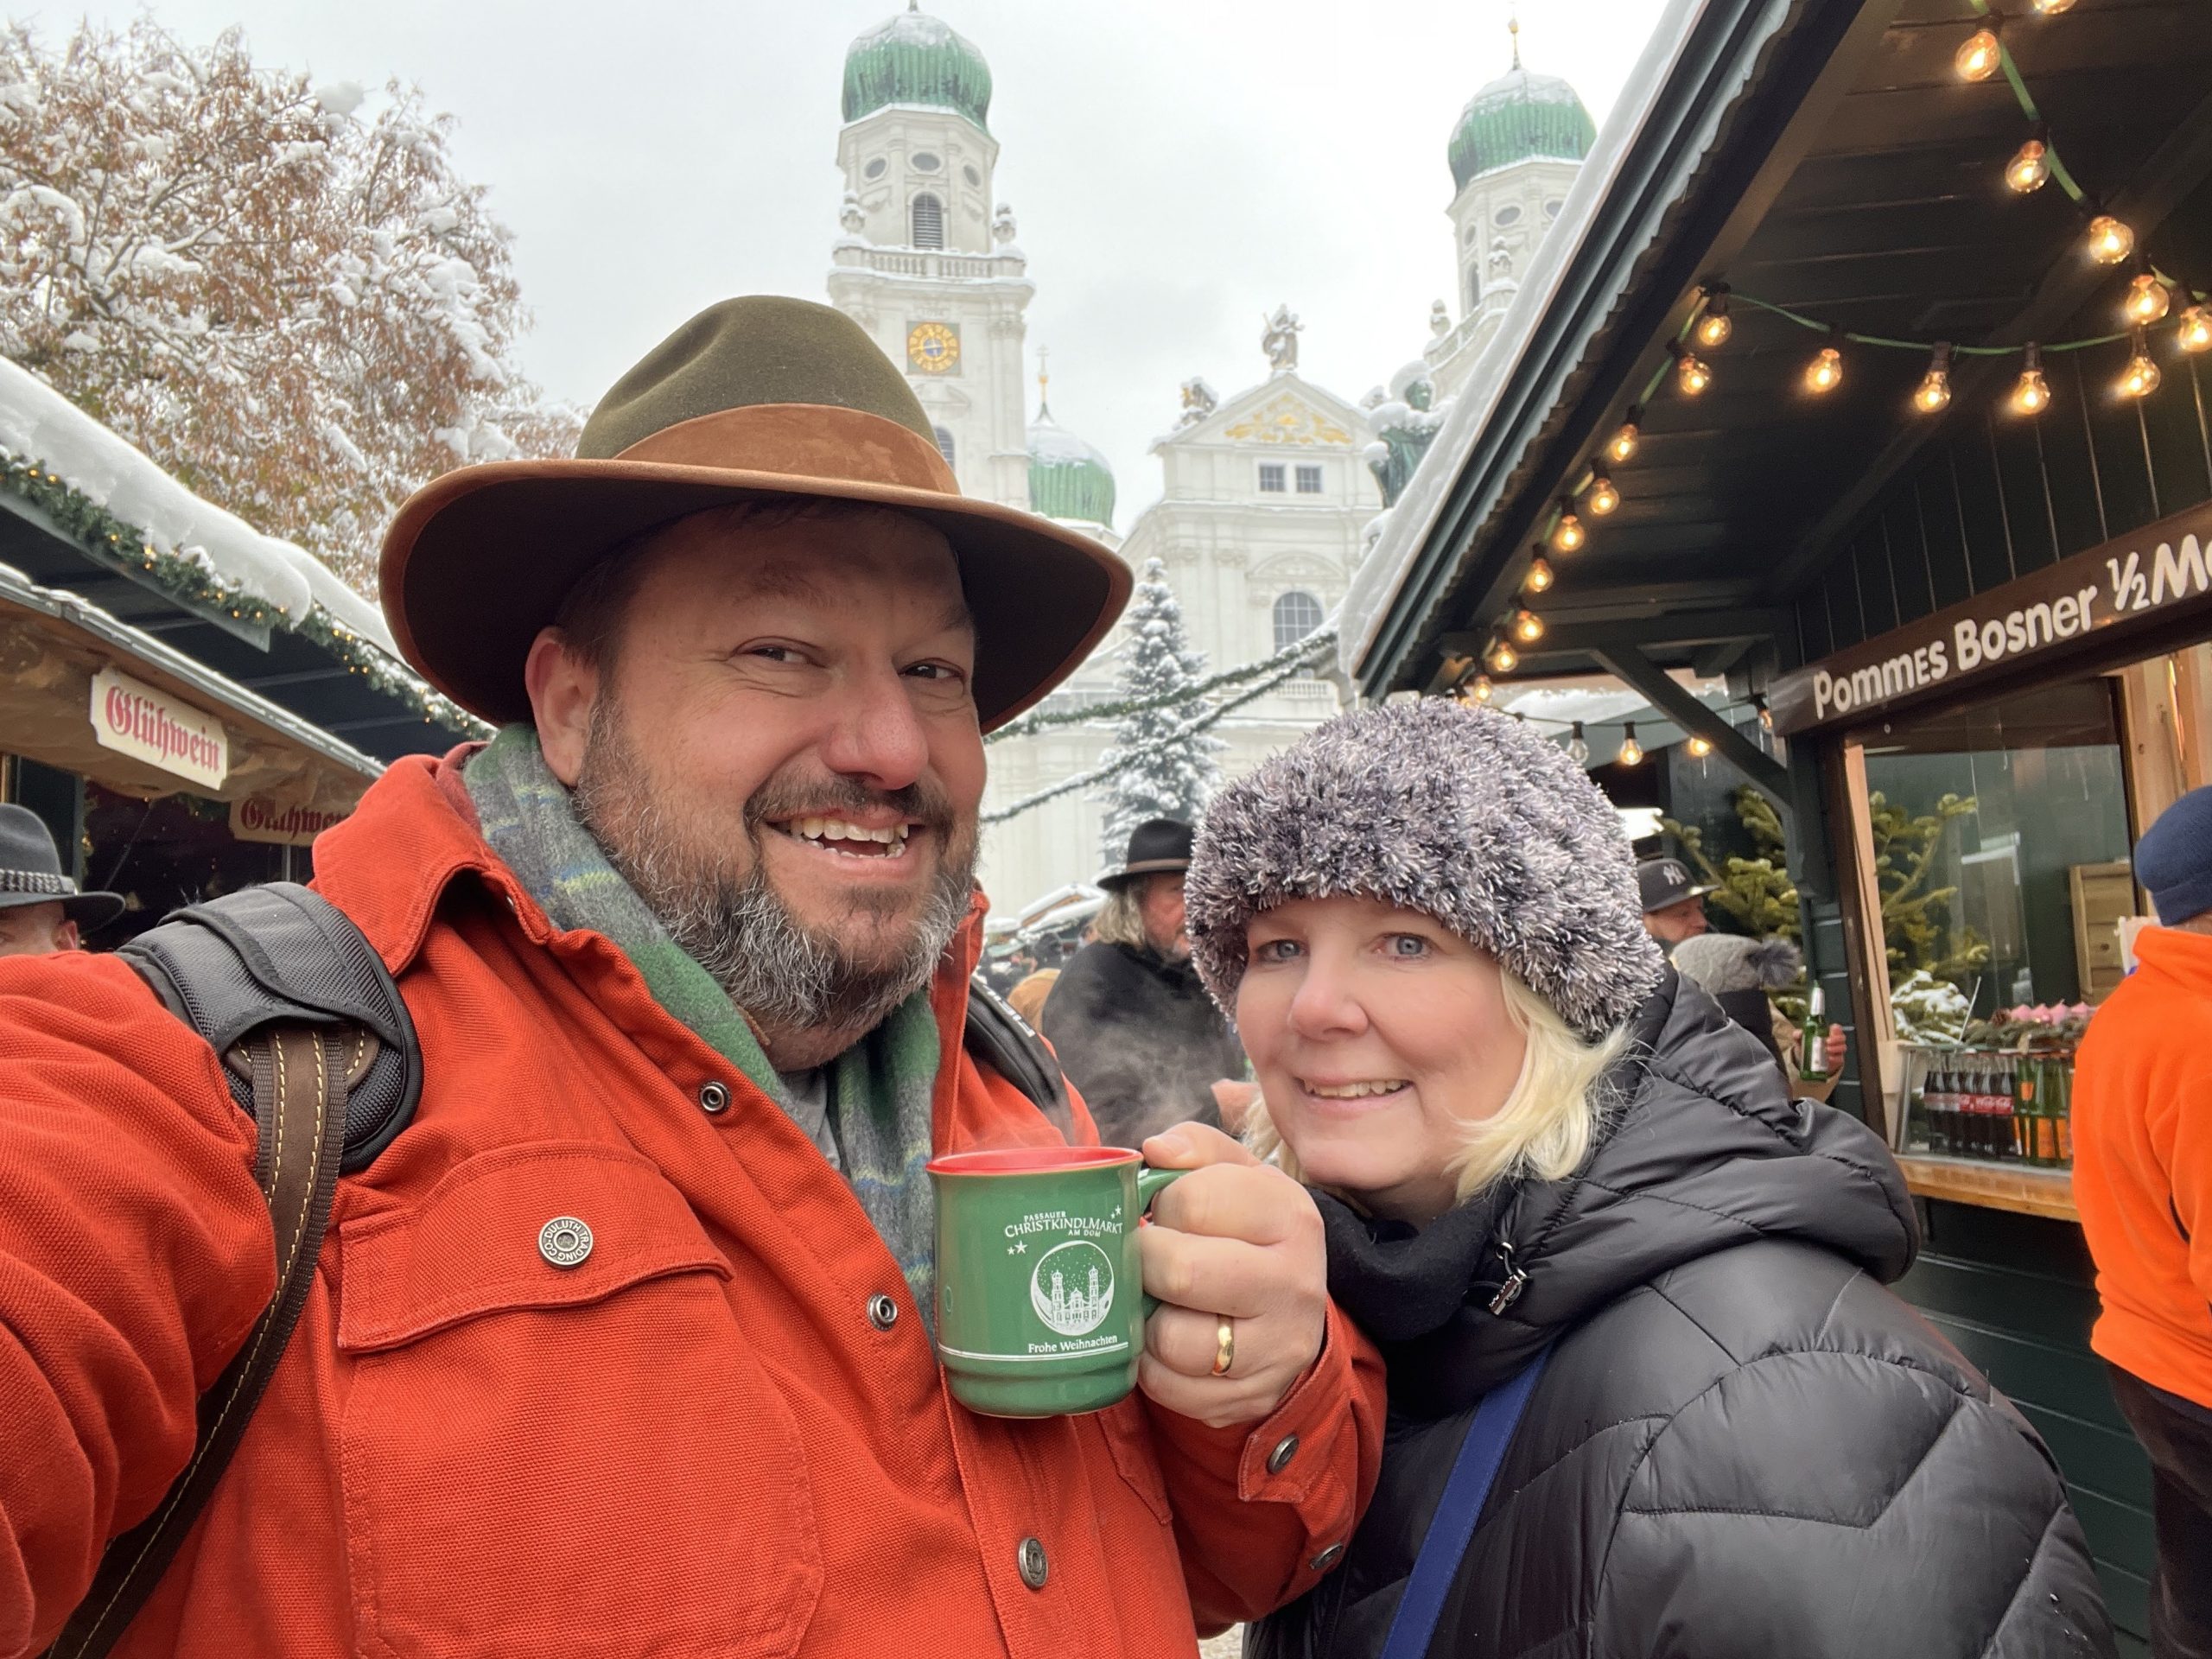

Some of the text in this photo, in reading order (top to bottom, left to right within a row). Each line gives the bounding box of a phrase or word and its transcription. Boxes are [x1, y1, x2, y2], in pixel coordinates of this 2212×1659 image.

[1954, 585, 2098, 671] Bosner
[105, 685, 220, 772] Glühwein
[1663, 864, 1686, 886] NY
[1024, 1211, 1066, 1222] PASSAUER
[543, 1220, 582, 1239] DULUTH
[1005, 1217, 1123, 1237] CHRISTKINDLMARKT
[1084, 1229, 1101, 1237] DOM
[557, 1230, 589, 1261] TRADING
[1028, 1335, 1118, 1353] Frohe Weihnachten
